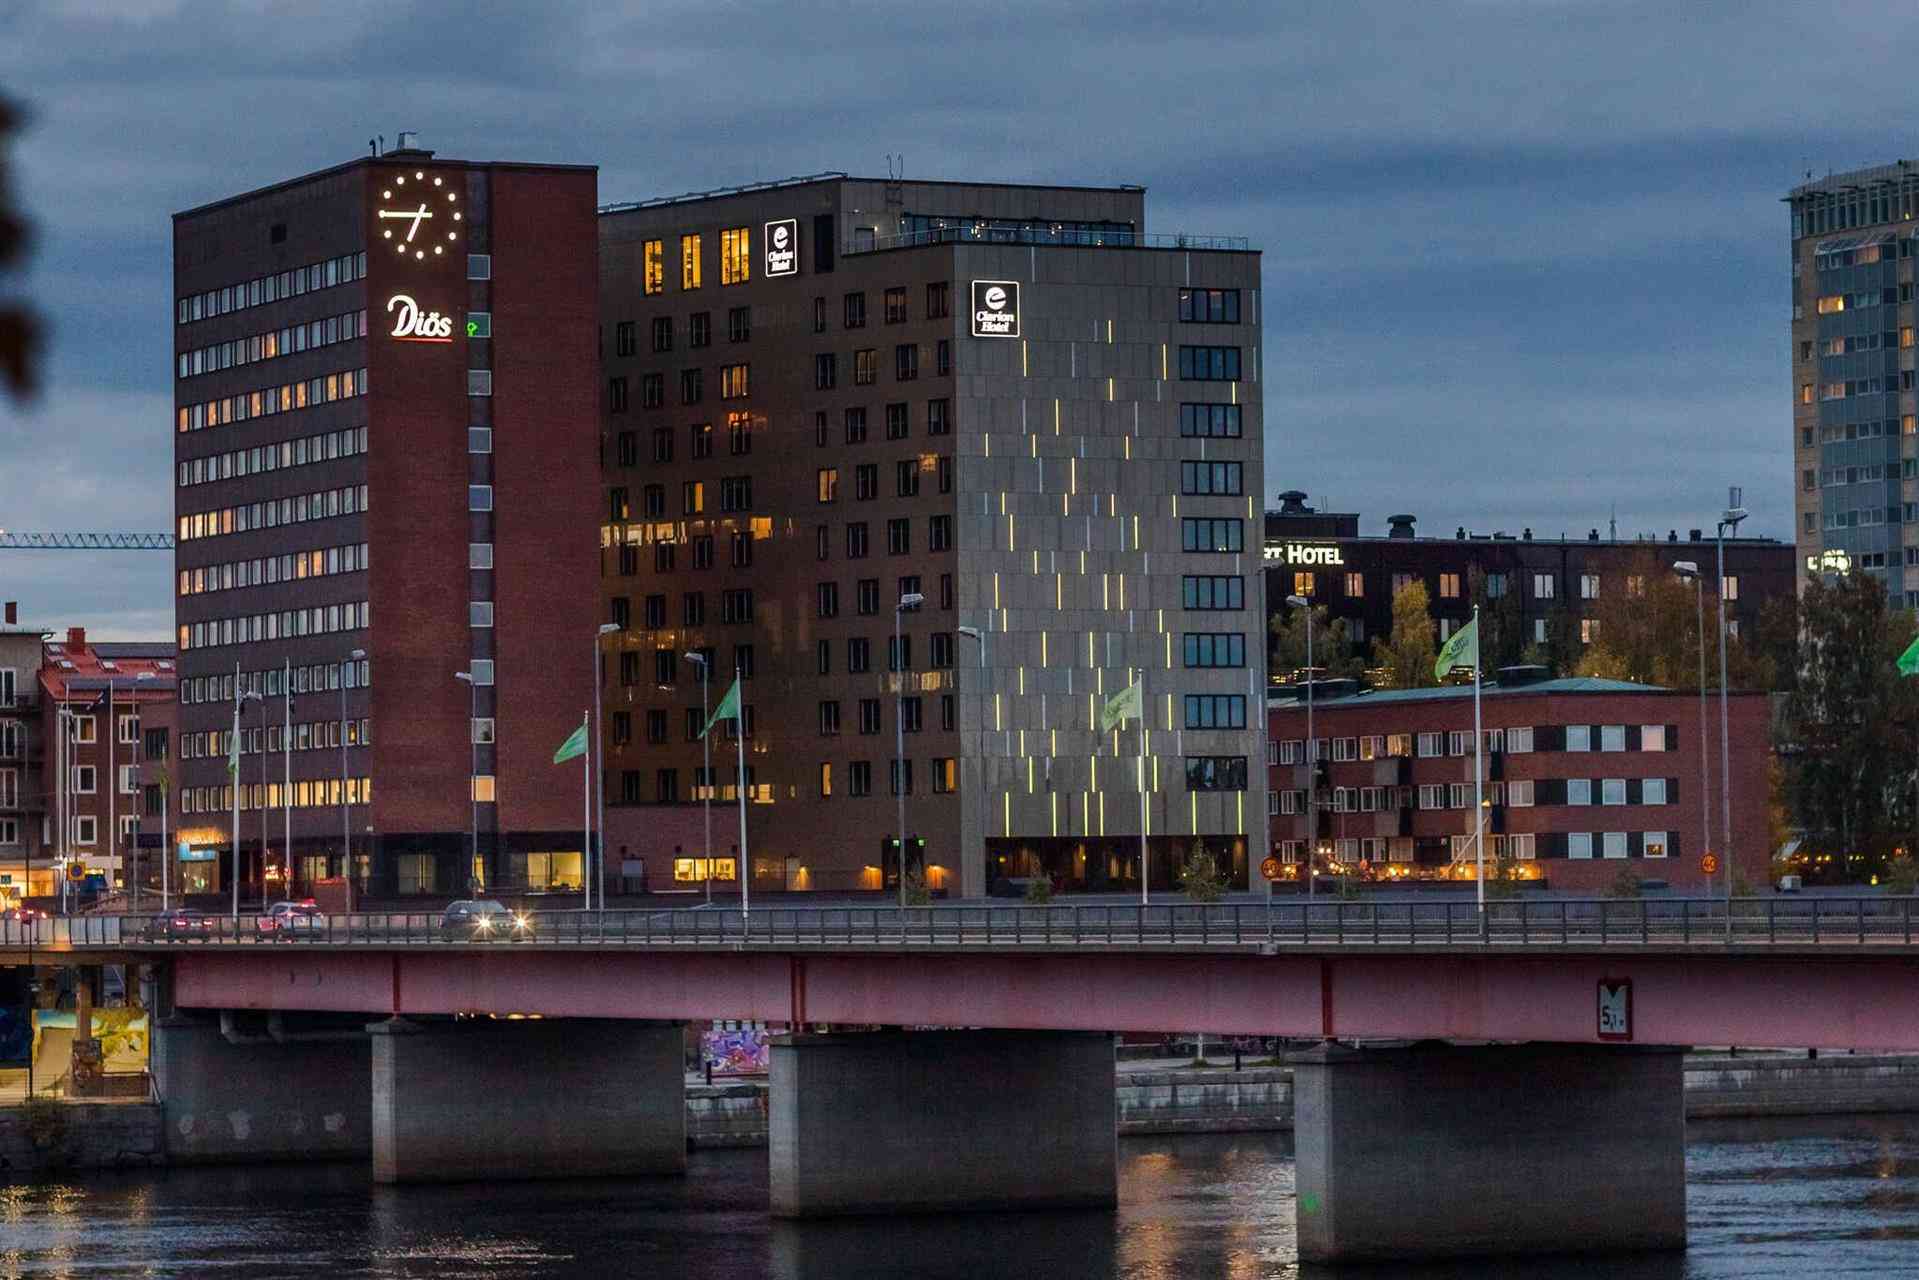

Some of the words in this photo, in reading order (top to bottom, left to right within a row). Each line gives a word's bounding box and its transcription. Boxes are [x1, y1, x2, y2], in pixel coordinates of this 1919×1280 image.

[388, 295, 452, 337] Diös
[976, 311, 1014, 322] Clarion
[981, 322, 1009, 332] Hotel
[1288, 544, 1344, 564] HOTEL
